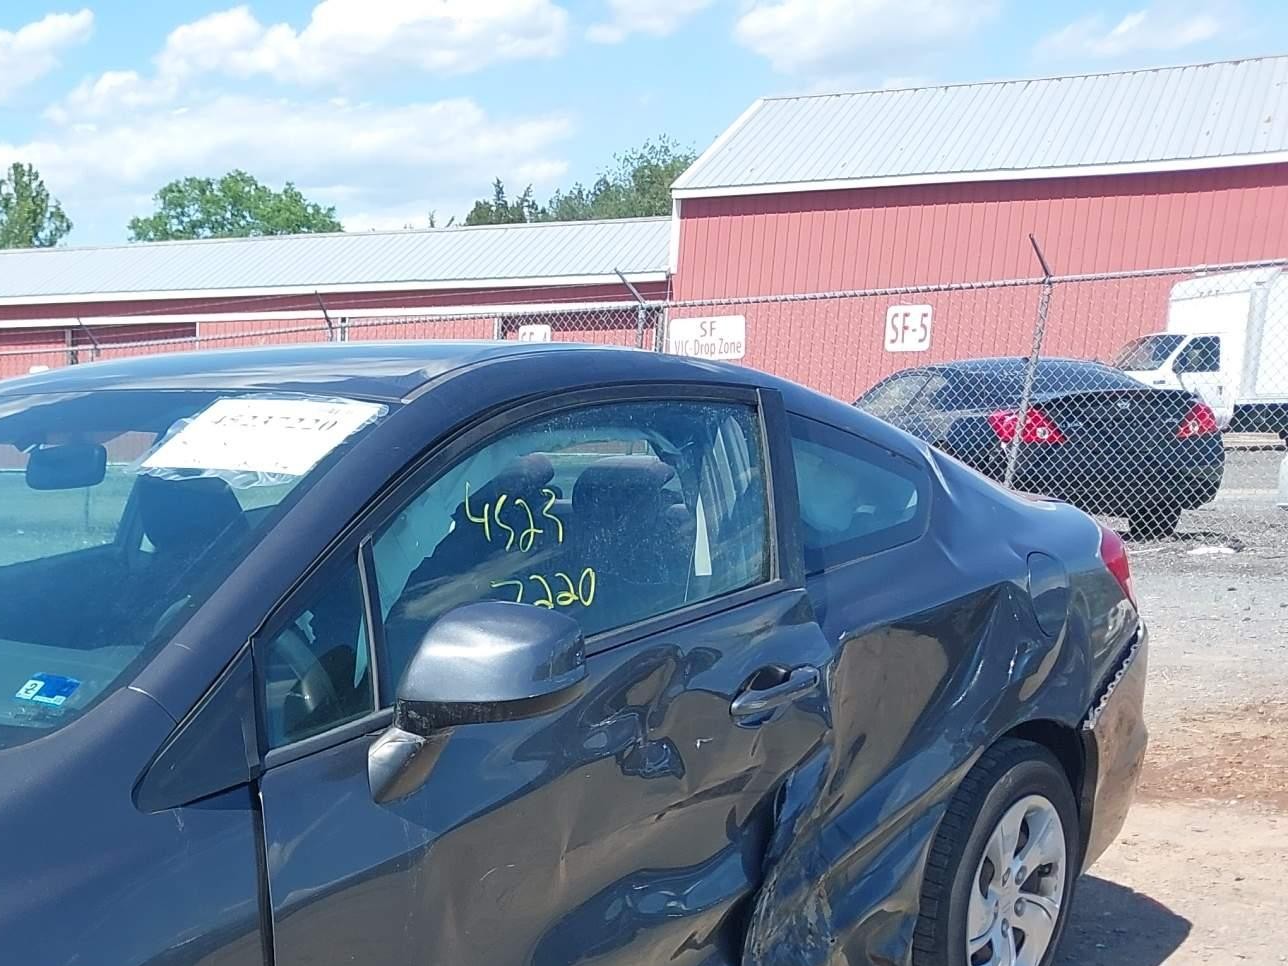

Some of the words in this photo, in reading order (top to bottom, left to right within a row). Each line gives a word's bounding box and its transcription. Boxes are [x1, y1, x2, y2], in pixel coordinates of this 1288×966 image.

[699, 320, 717, 338] SF
[890, 312, 928, 344] SF-5
[718, 337, 742, 354] Zone
[490, 567, 596, 609] 7220
